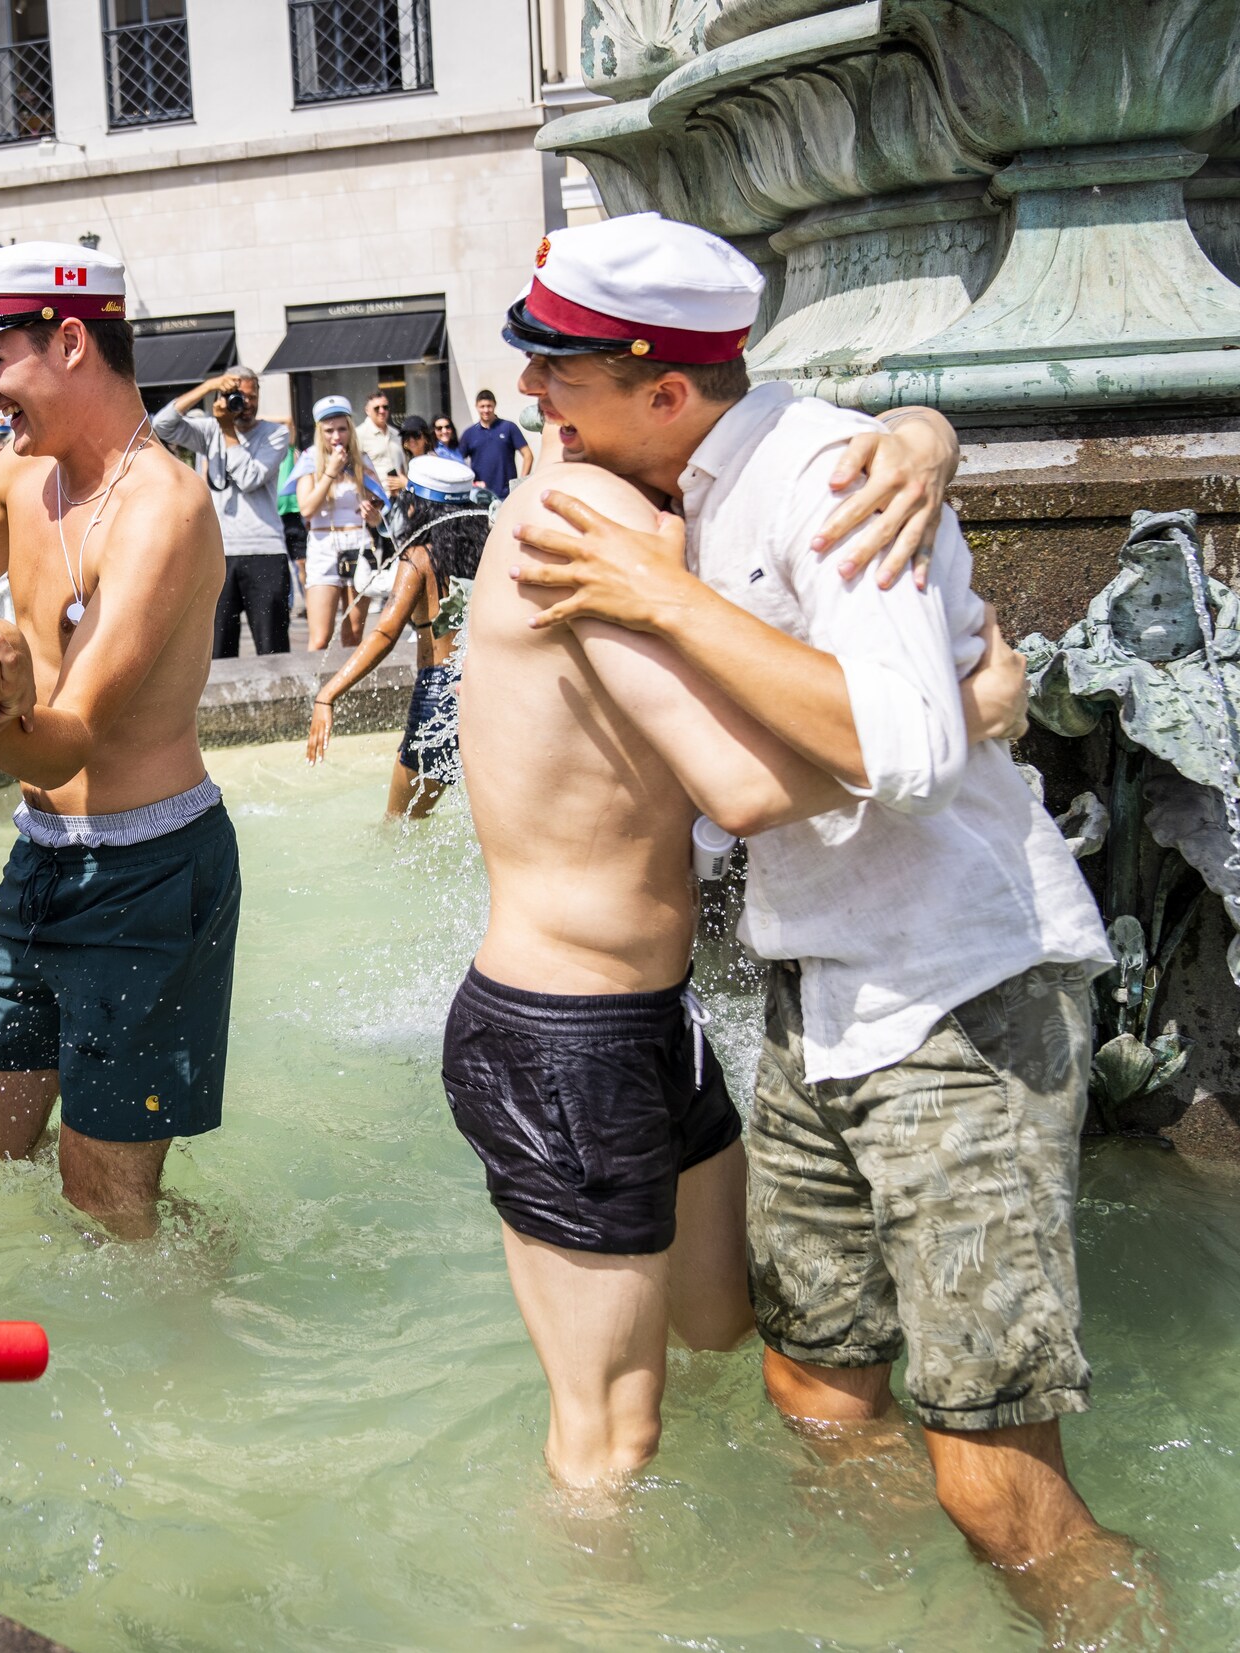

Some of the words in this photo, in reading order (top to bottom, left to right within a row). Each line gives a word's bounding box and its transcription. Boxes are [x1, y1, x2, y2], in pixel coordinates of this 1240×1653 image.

[101, 301, 122, 312] Milan
[328, 304, 363, 316] GEORG
[366, 301, 404, 314] JENSEN
